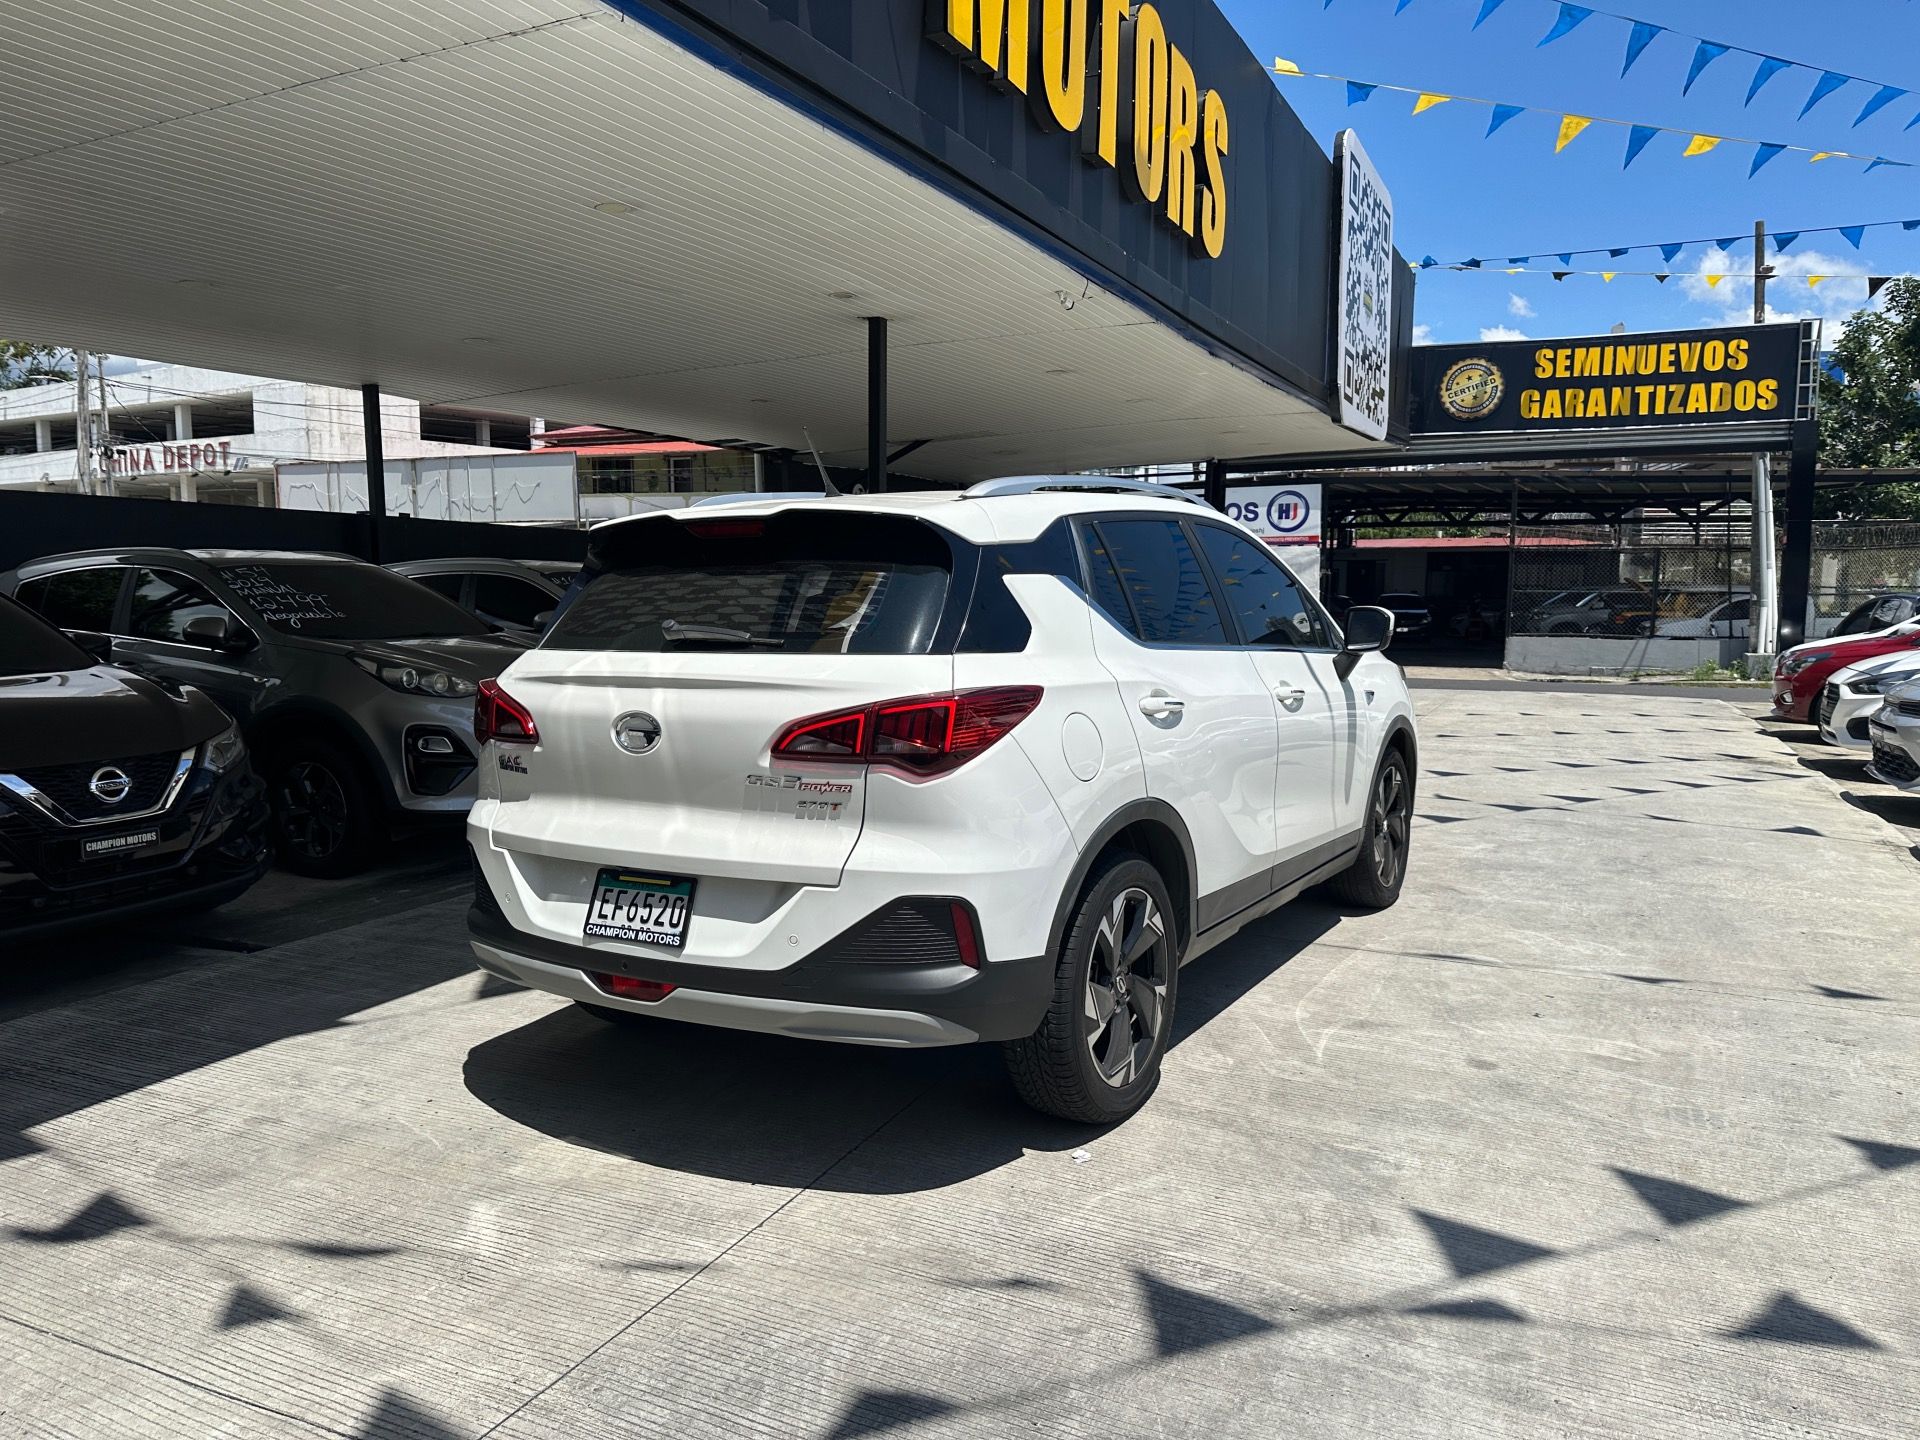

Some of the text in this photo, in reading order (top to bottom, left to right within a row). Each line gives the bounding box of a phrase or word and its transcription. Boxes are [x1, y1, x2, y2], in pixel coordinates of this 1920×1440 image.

[1534, 339, 1749, 379] SEMINUEVOS
[1447, 378, 1497, 399] CERTIFIED
[1520, 378, 1779, 419] GARANTIZADOS
[162, 441, 231, 470] DEPOT
[1277, 502, 1298, 521] HJ
[236, 584, 302, 597] MANUAL
[800, 781, 853, 795] POWER
[86, 837, 126, 852] CHAMPION
[126, 832, 157, 845] MOTORS
[597, 887, 686, 928] EF6520
[586, 924, 637, 940] CHAMPION
[637, 930, 681, 946] MOTORS
